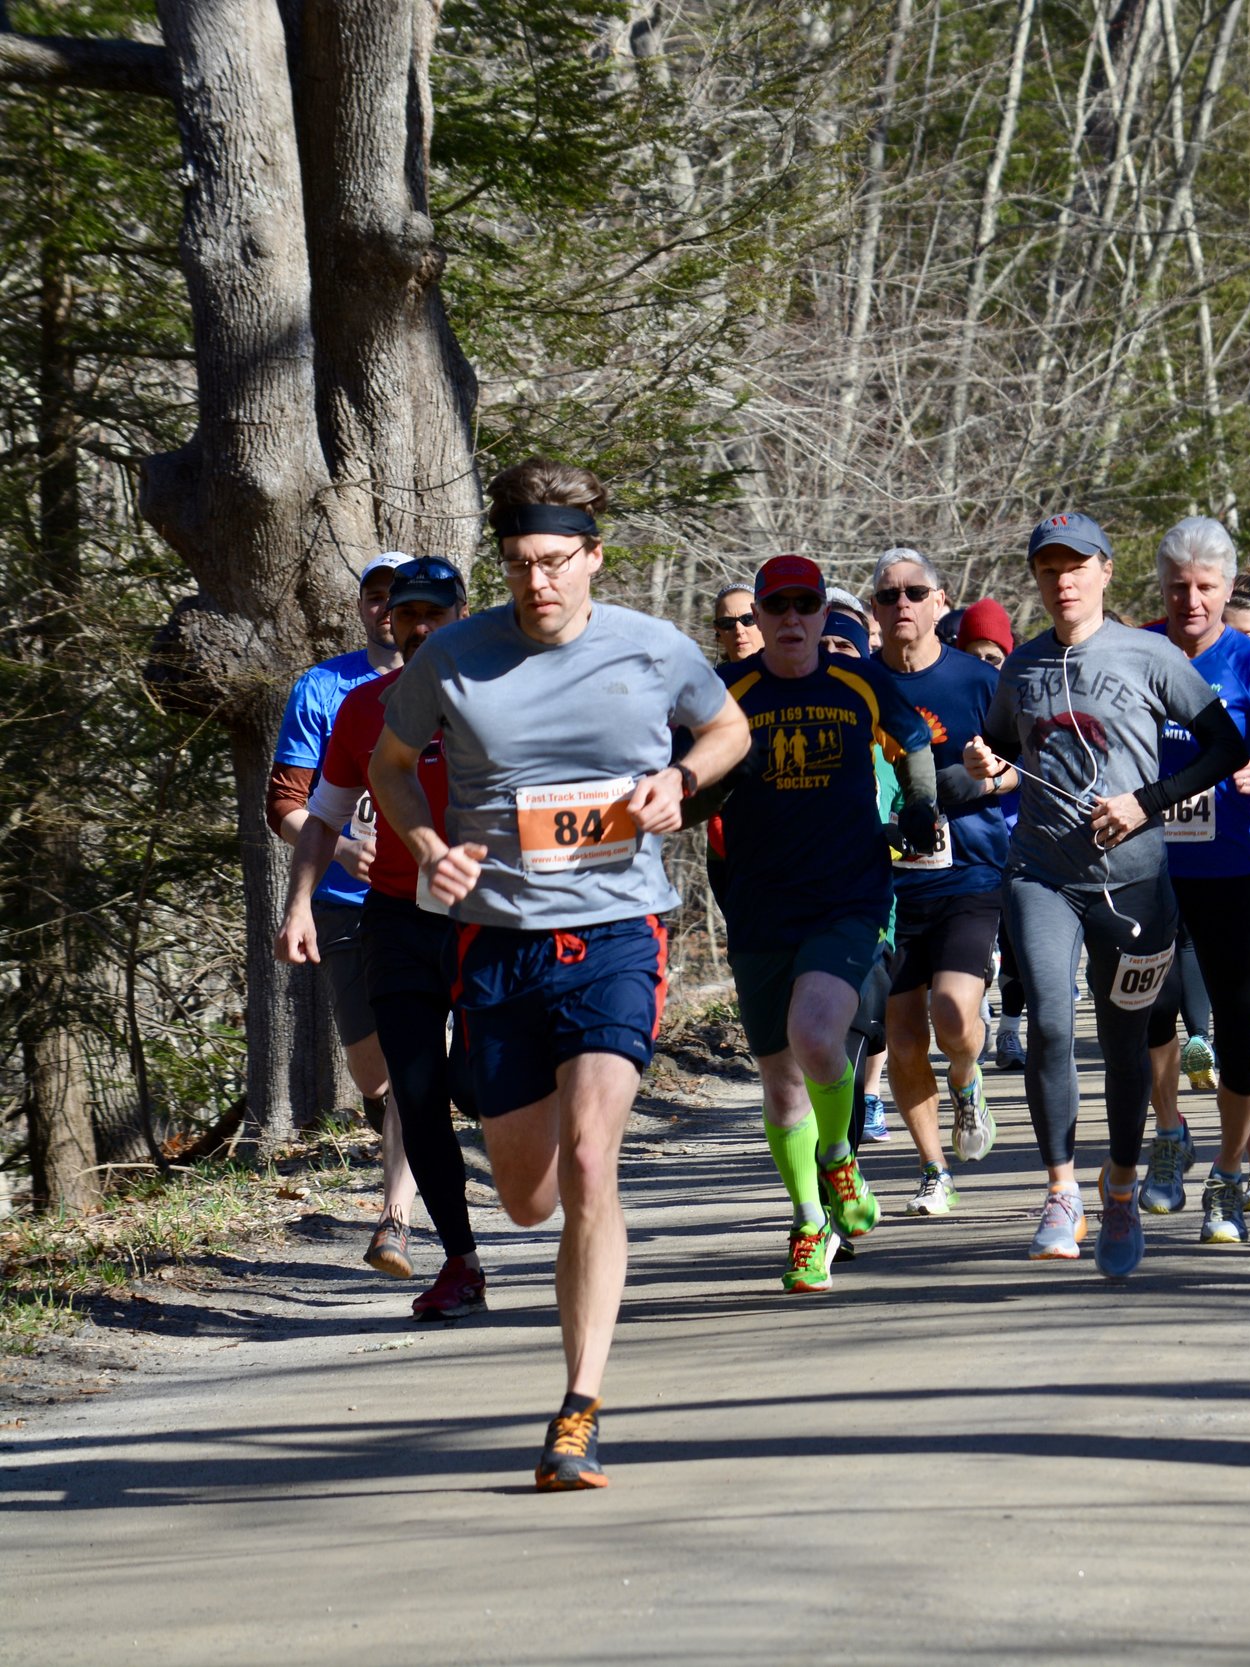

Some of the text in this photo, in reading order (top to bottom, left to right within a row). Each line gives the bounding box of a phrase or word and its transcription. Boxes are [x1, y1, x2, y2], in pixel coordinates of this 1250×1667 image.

[1071, 661, 1134, 712] LIFE
[780, 706, 802, 722] 169
[806, 706, 857, 726] TOWNS
[776, 774, 831, 790] SOCIETY
[525, 795, 546, 803] Fast
[549, 793, 575, 802] Track
[578, 790, 609, 801] Timing
[554, 809, 605, 846] 84
